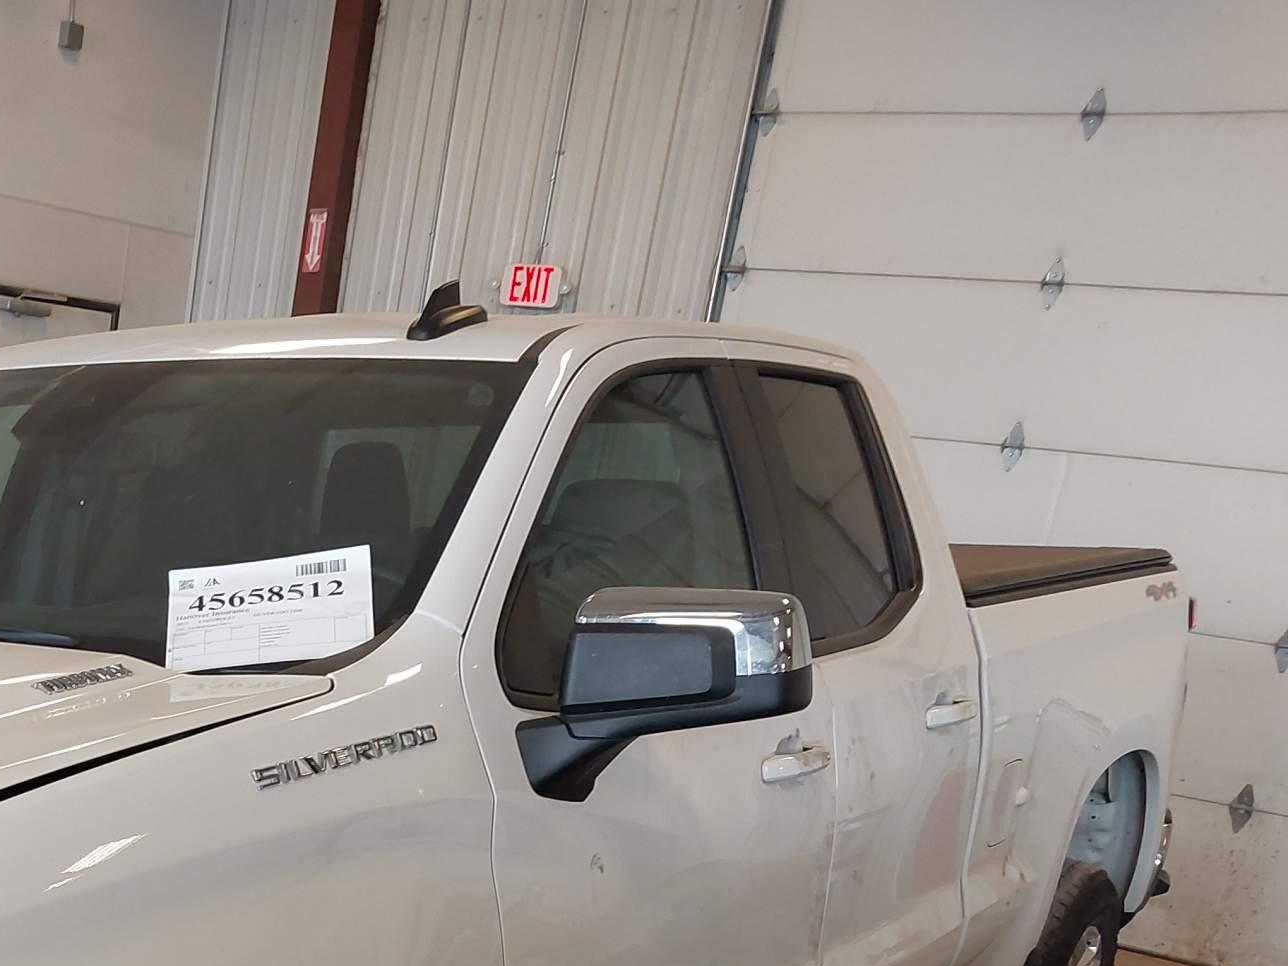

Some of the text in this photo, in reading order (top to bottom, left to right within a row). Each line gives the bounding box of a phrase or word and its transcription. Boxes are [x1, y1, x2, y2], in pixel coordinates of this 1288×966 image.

[508, 266, 556, 304] EXIT
[188, 579, 345, 612] 45658512
[249, 724, 439, 791] SILVERADO
